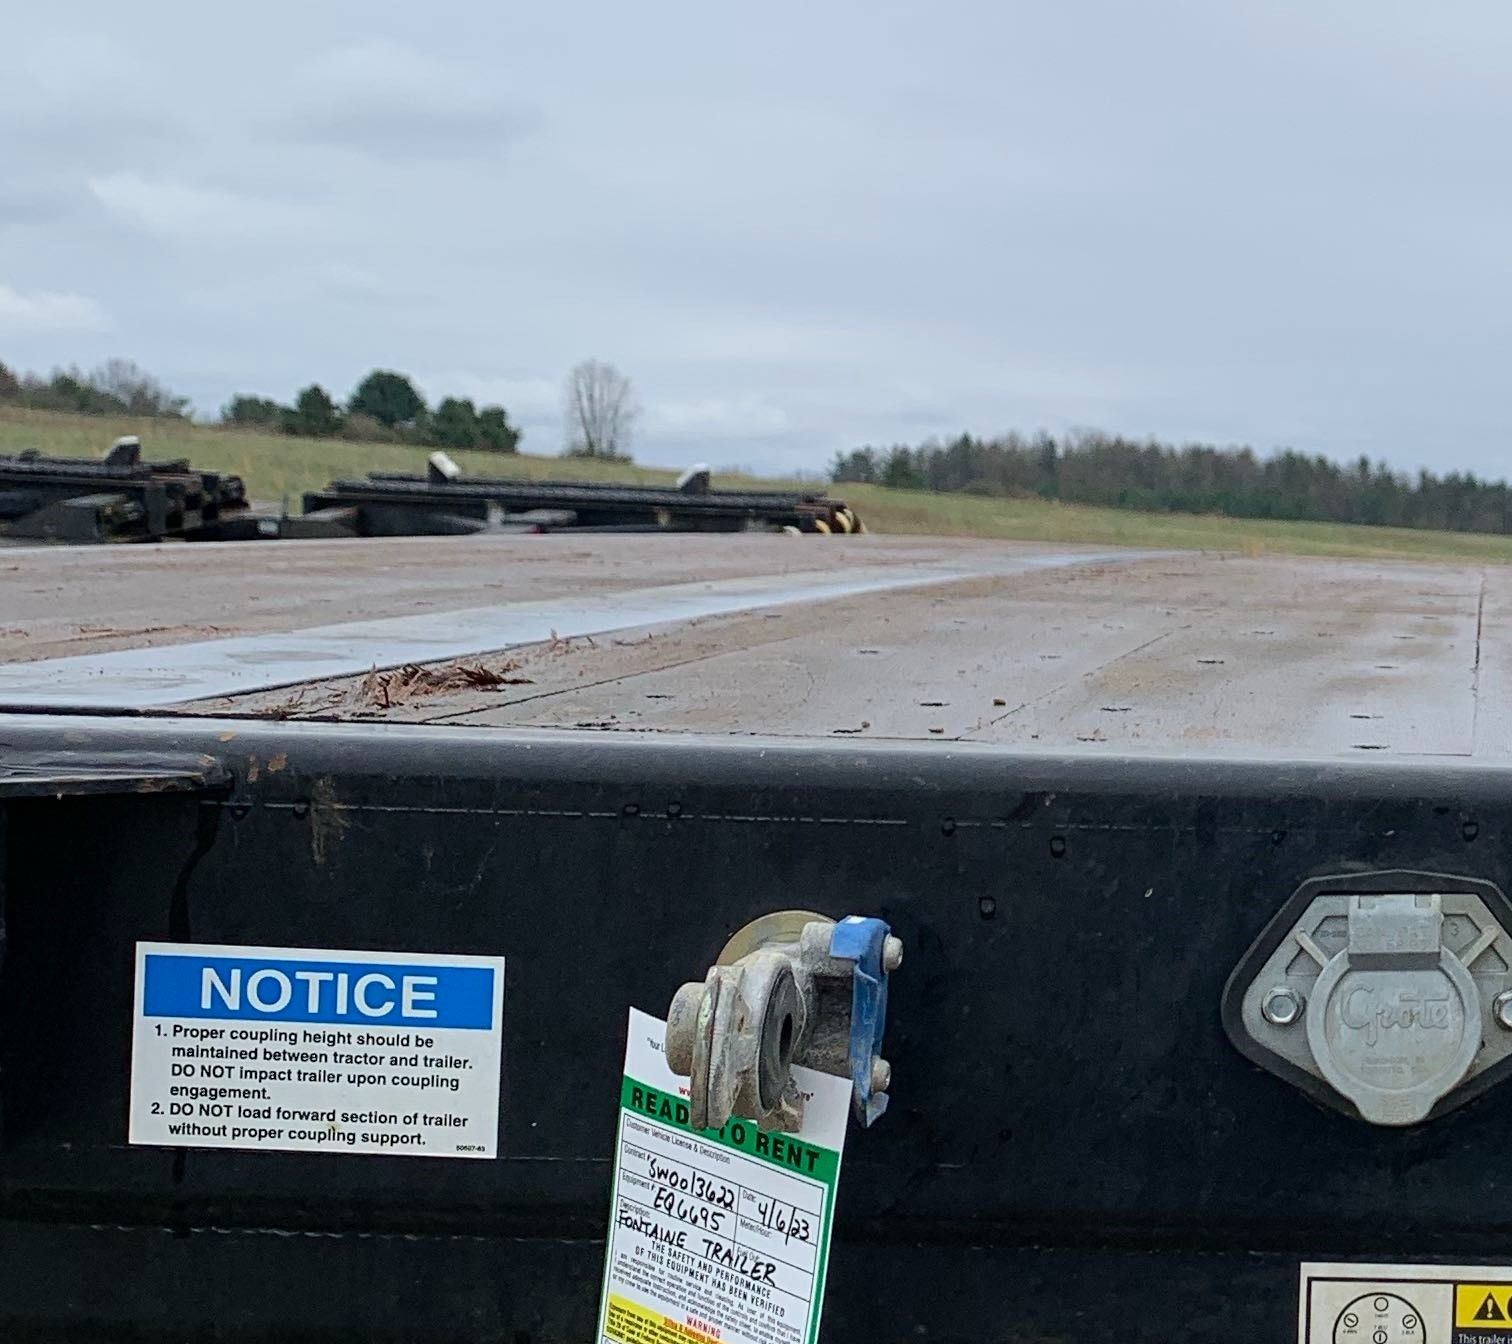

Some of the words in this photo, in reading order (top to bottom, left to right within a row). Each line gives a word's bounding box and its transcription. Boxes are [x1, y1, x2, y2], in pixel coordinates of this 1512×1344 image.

[200, 964, 439, 1019] NOTICE
[1341, 985, 1450, 1047] Grote
[154, 1023, 167, 1040] 1.
[172, 1024, 225, 1042] Proper
[229, 1026, 297, 1046] coupling
[302, 1029, 351, 1048] height
[356, 1032, 410, 1050] should
[414, 1034, 433, 1051] be
[171, 1044, 258, 1061] maintained
[263, 1047, 328, 1064] between
[332, 1050, 385, 1066] tractor
[389, 1052, 417, 1068] and
[422, 1054, 473, 1070] trailer.
[170, 1063, 195, 1080] DO
[200, 1064, 234, 1081] NOT
[239, 1066, 291, 1084] impact
[296, 1068, 342, 1086] trailer
[347, 1070, 382, 1087] upon
[387, 1072, 459, 1090] coupling
[170, 1083, 271, 1102] engagement.
[151, 1102, 164, 1116] 2.
[169, 1102, 193, 1117] DO
[198, 1104, 233, 1119] NOT
[237, 1105, 270, 1120] load
[275, 1107, 335, 1123] forward
[340, 1109, 398, 1126] section
[402, 1112, 417, 1126] of
[422, 1113, 468, 1128] trailer
[168, 1122, 227, 1139] without
[231, 1124, 283, 1142] proper
[288, 1126, 355, 1144] coupling
[360, 1129, 426, 1147] support.
[632, 1087, 688, 1124] READ
[756, 1132, 818, 1171] RENT
[617, 1208, 688, 1249] FONTAINE
[702, 1238, 776, 1288] TRAILER
[635, 1246, 644, 1255] OF
[647, 1250, 663, 1264] THIS
[666, 1259, 708, 1283] EQUIPMENT
[711, 1278, 725, 1291] HAS
[729, 1285, 746, 1300] BEEN
[751, 1295, 784, 1316] VERIFIED
[652, 1240, 664, 1253] THE
[668, 1248, 694, 1265] SAFETY
[697, 1260, 712, 1273] AND
[716, 1268, 770, 1298] PERFORMANCE
[687, 1316, 720, 1338] WARNING
[1458, 1333, 1476, 1344] This
